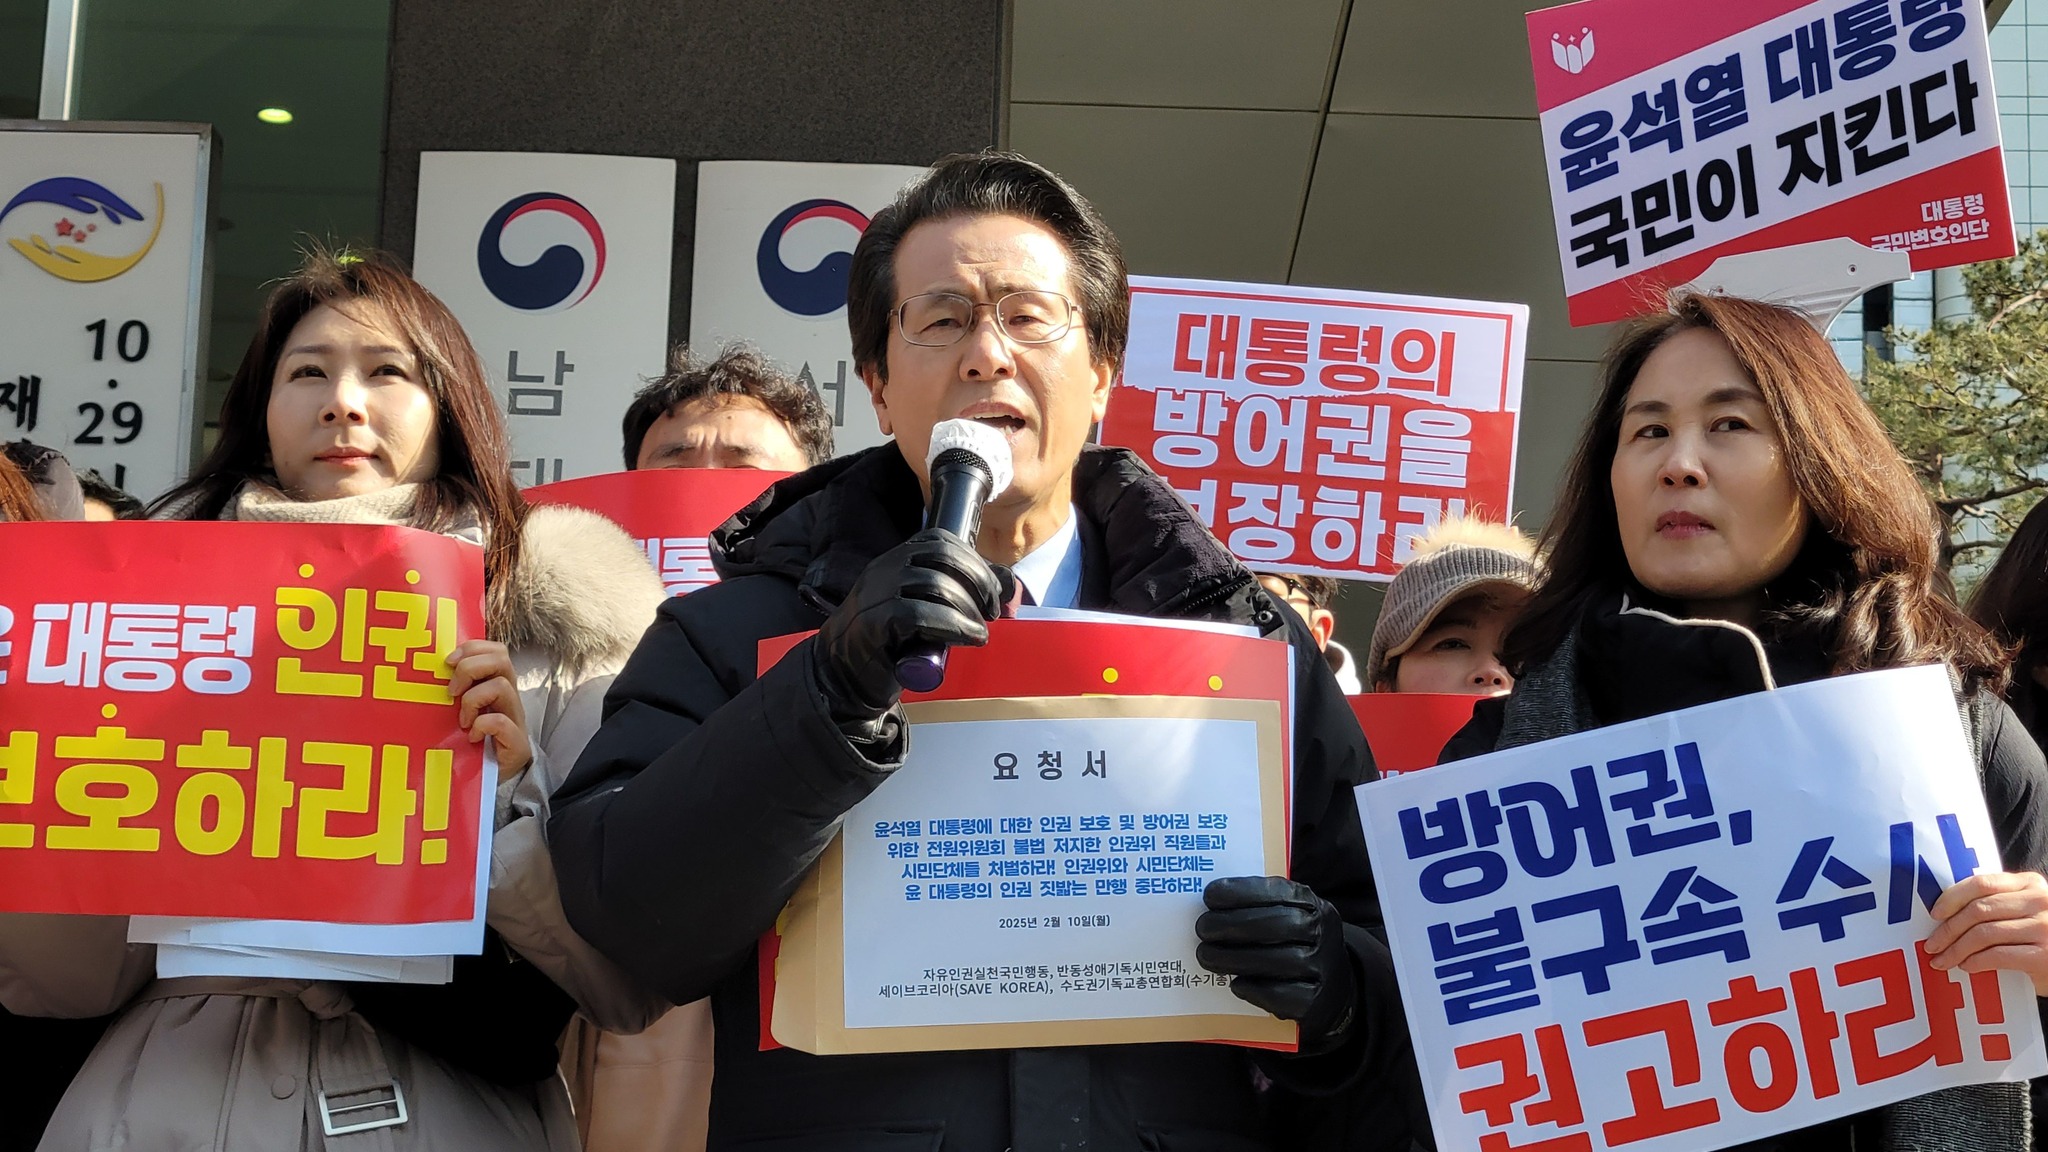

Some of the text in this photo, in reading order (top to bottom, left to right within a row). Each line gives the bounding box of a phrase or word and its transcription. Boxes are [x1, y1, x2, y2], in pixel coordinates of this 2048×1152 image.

[1559, 52, 1749, 193] 윤석열
[1569, 59, 1979, 269] 국민이 지킨다
[1921, 193, 1985, 222] 대통령
[1871, 218, 1990, 252] 국민변호인단
[1173, 313, 1456, 397] 대통령의
[1151, 389, 1473, 489] 방어권을
[26, 602, 256, 695] 대통령
[275, 564, 458, 706] 인권
[874, 813, 1229, 839] 윤석열 대통령에 대한 인권 보호 및 방어권 보장
[1397, 741, 1753, 904] 방어권,
[887, 834, 1227, 858] 위한 전원위원회 불법 저지한 인권위 직원들과
[901, 855, 1215, 880] 시민단체들 처벌하라! 인권위와 시민단체는
[905, 876, 1203, 901] 윤 대통령의 인권 짓밟는 만행 중단하라!
[999, 914, 1111, 929] 2025년 2월 10일(월)
[1427, 813, 1980, 1025] 불구속 수사
[923, 960, 1187, 982] 자유인권실천국민행동, 반동성애기독시민연대,
[878, 983, 992, 998] 세이브코리아(SAVE
[1000, 980, 1054, 995] KOREA),
[1453, 938, 2012, 1152] 권고하라!
